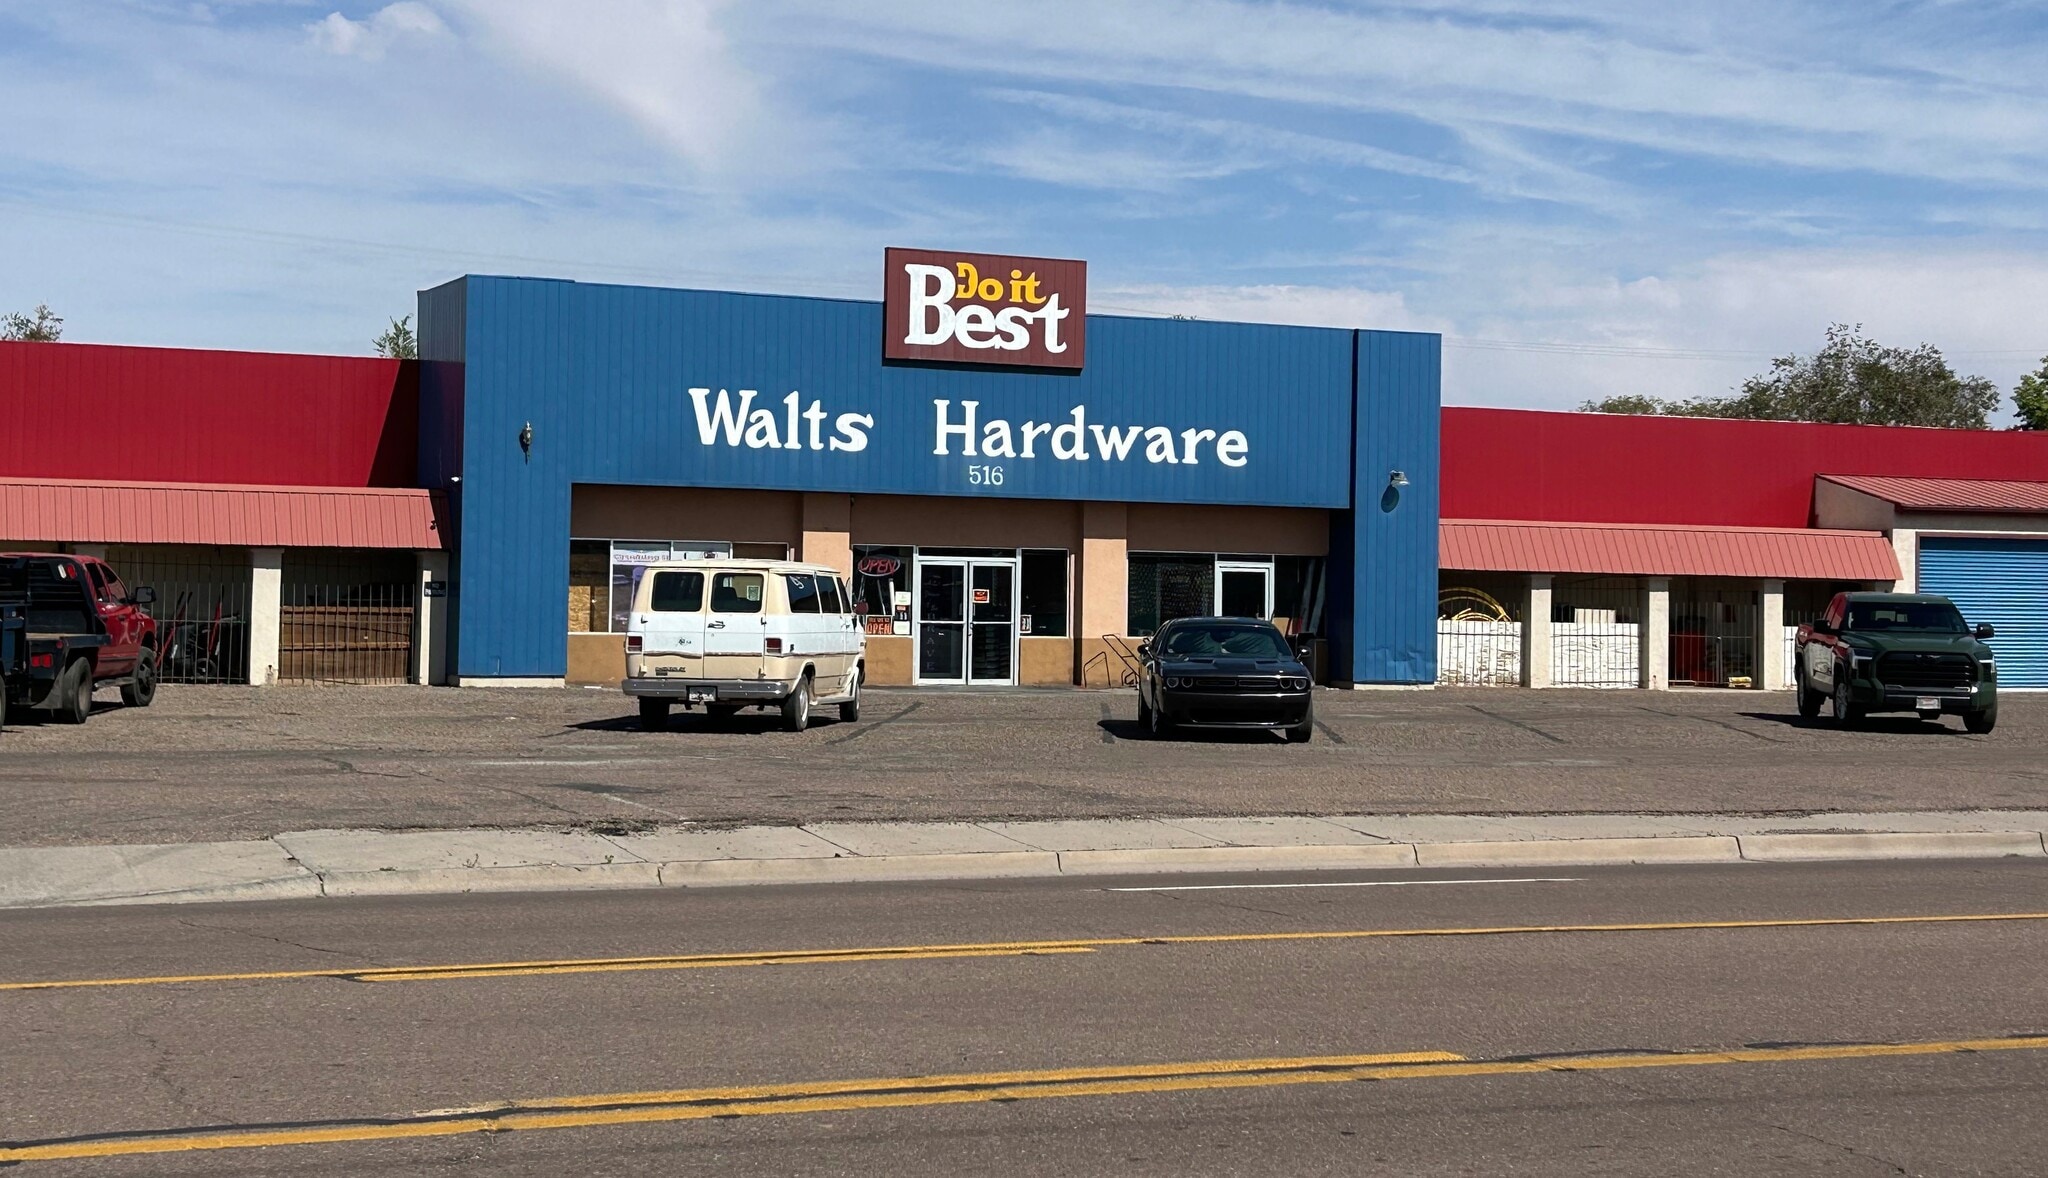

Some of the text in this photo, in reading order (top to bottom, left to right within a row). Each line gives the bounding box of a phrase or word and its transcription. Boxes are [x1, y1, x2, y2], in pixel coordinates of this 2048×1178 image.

[956, 262, 1047, 305] Do it
[904, 263, 1070, 354] Best
[688, 387, 1249, 468] Walts Hardware
[968, 464, 1004, 486] 516
[860, 558, 897, 575] OPEN
[867, 622, 892, 635] OPEN
